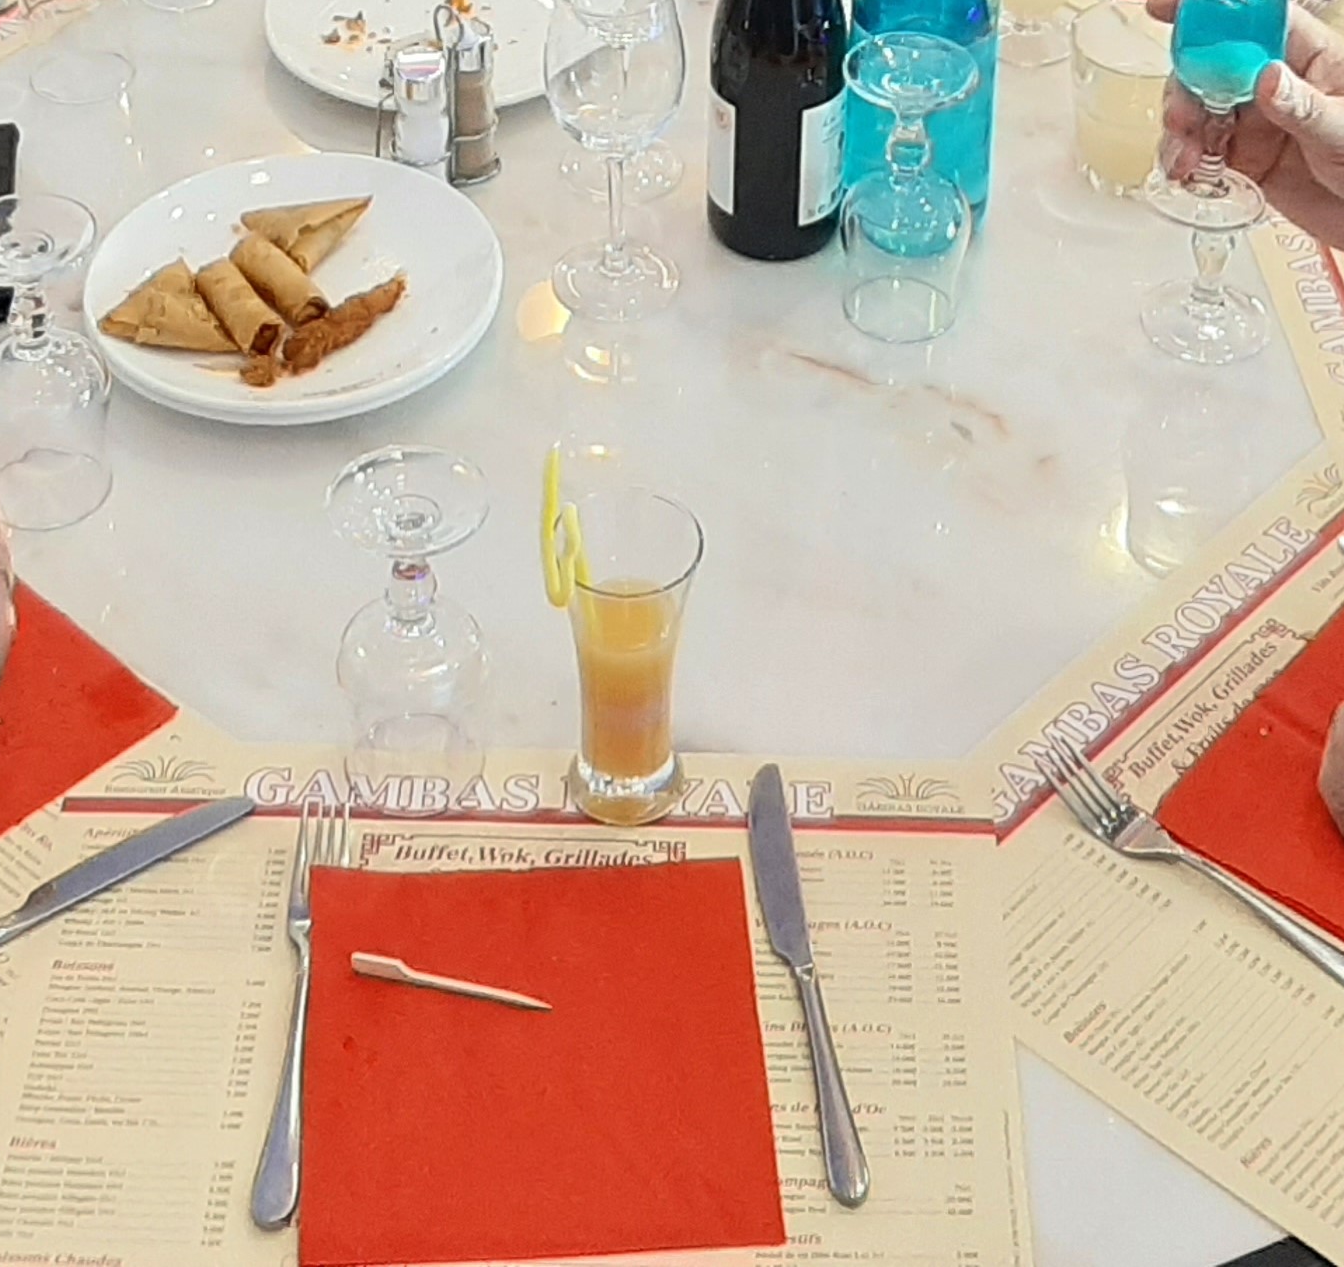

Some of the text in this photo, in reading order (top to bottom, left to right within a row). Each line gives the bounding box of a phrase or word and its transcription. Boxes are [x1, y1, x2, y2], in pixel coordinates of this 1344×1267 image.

[1141, 515, 1320, 665] ROYALE
[1211, 639, 1279, 702] Grillades
[244, 766, 541, 814] GAMBAS
[543, 847, 654, 868] Grillades
